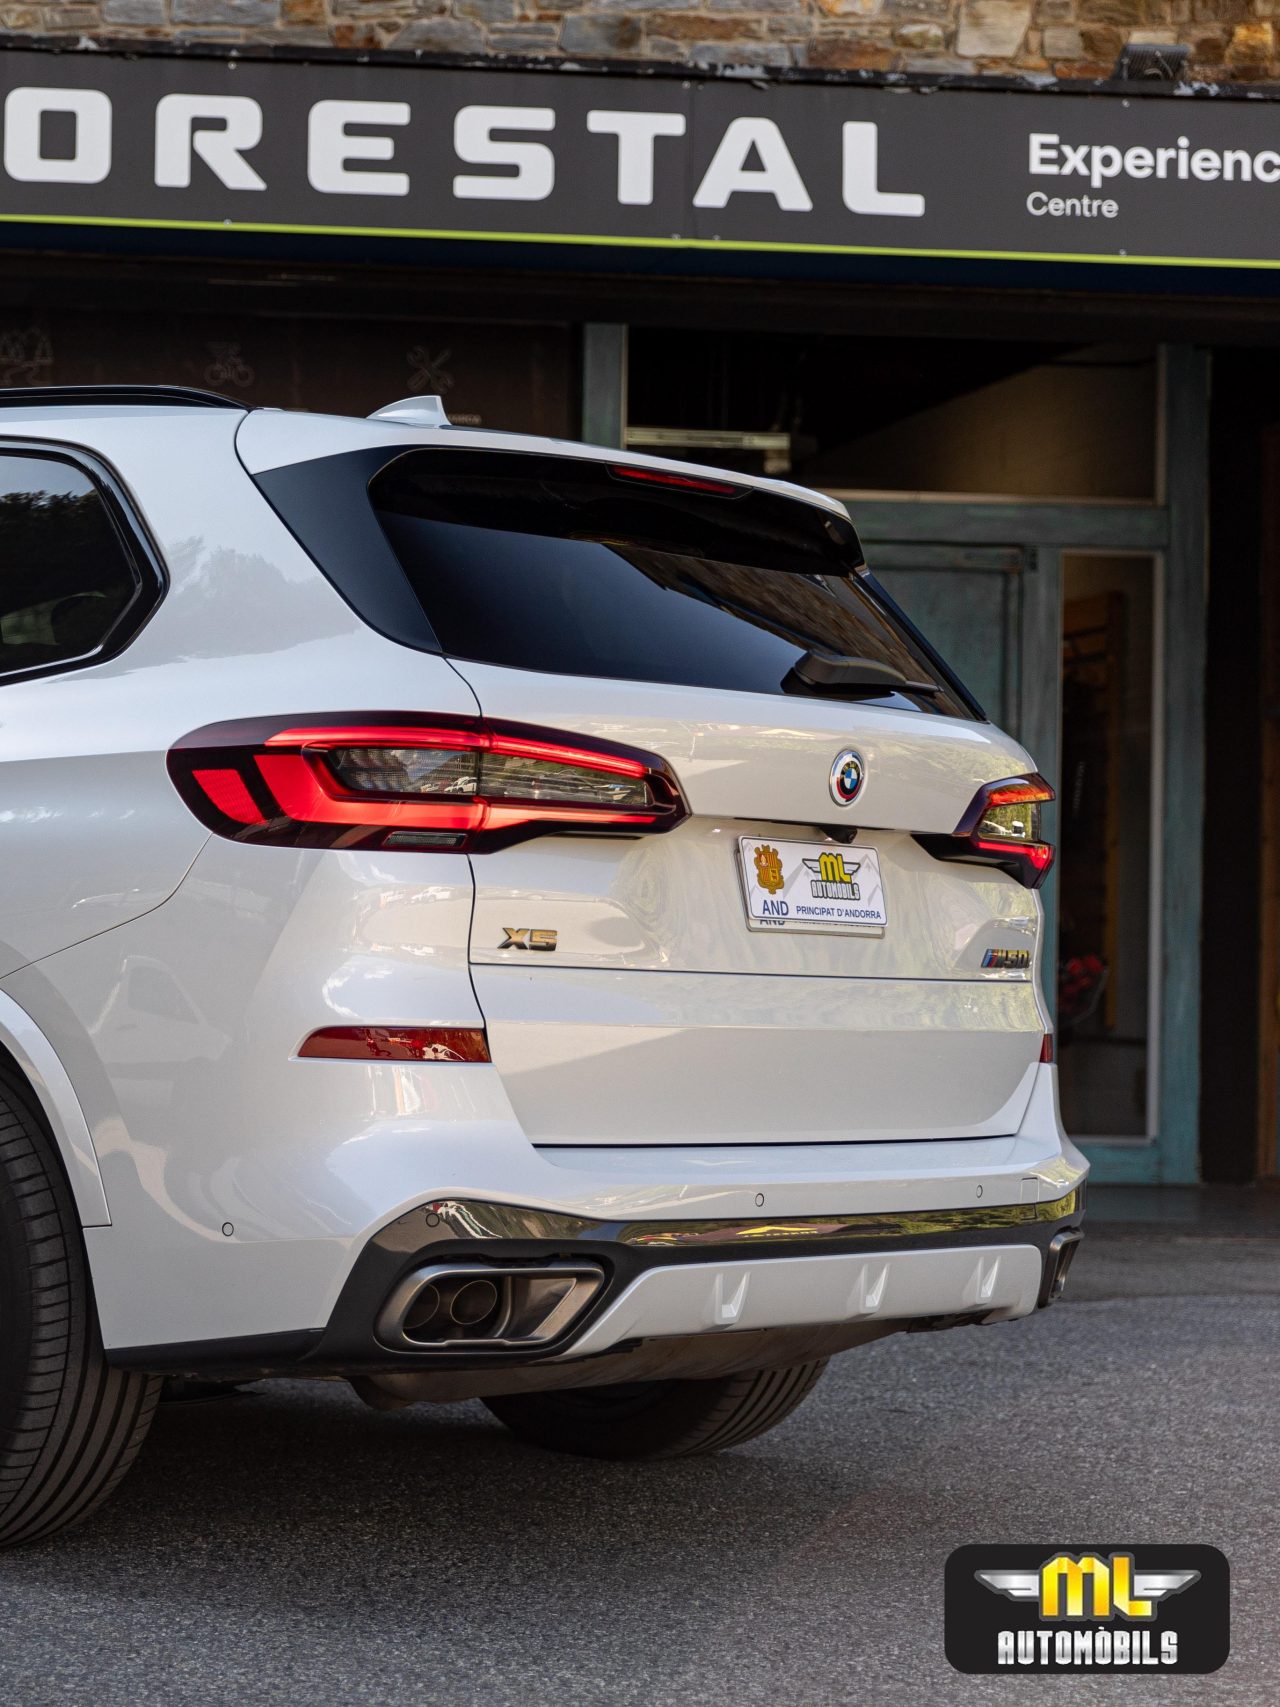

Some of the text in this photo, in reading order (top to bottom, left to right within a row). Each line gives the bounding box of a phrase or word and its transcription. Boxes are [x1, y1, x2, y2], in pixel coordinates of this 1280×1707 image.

[1026, 191, 1119, 218] Centre
[819, 852, 853, 884] ML
[762, 900, 882, 919] AND PRINCIPAT D'ANDORRA
[497, 927, 558, 952] X5
